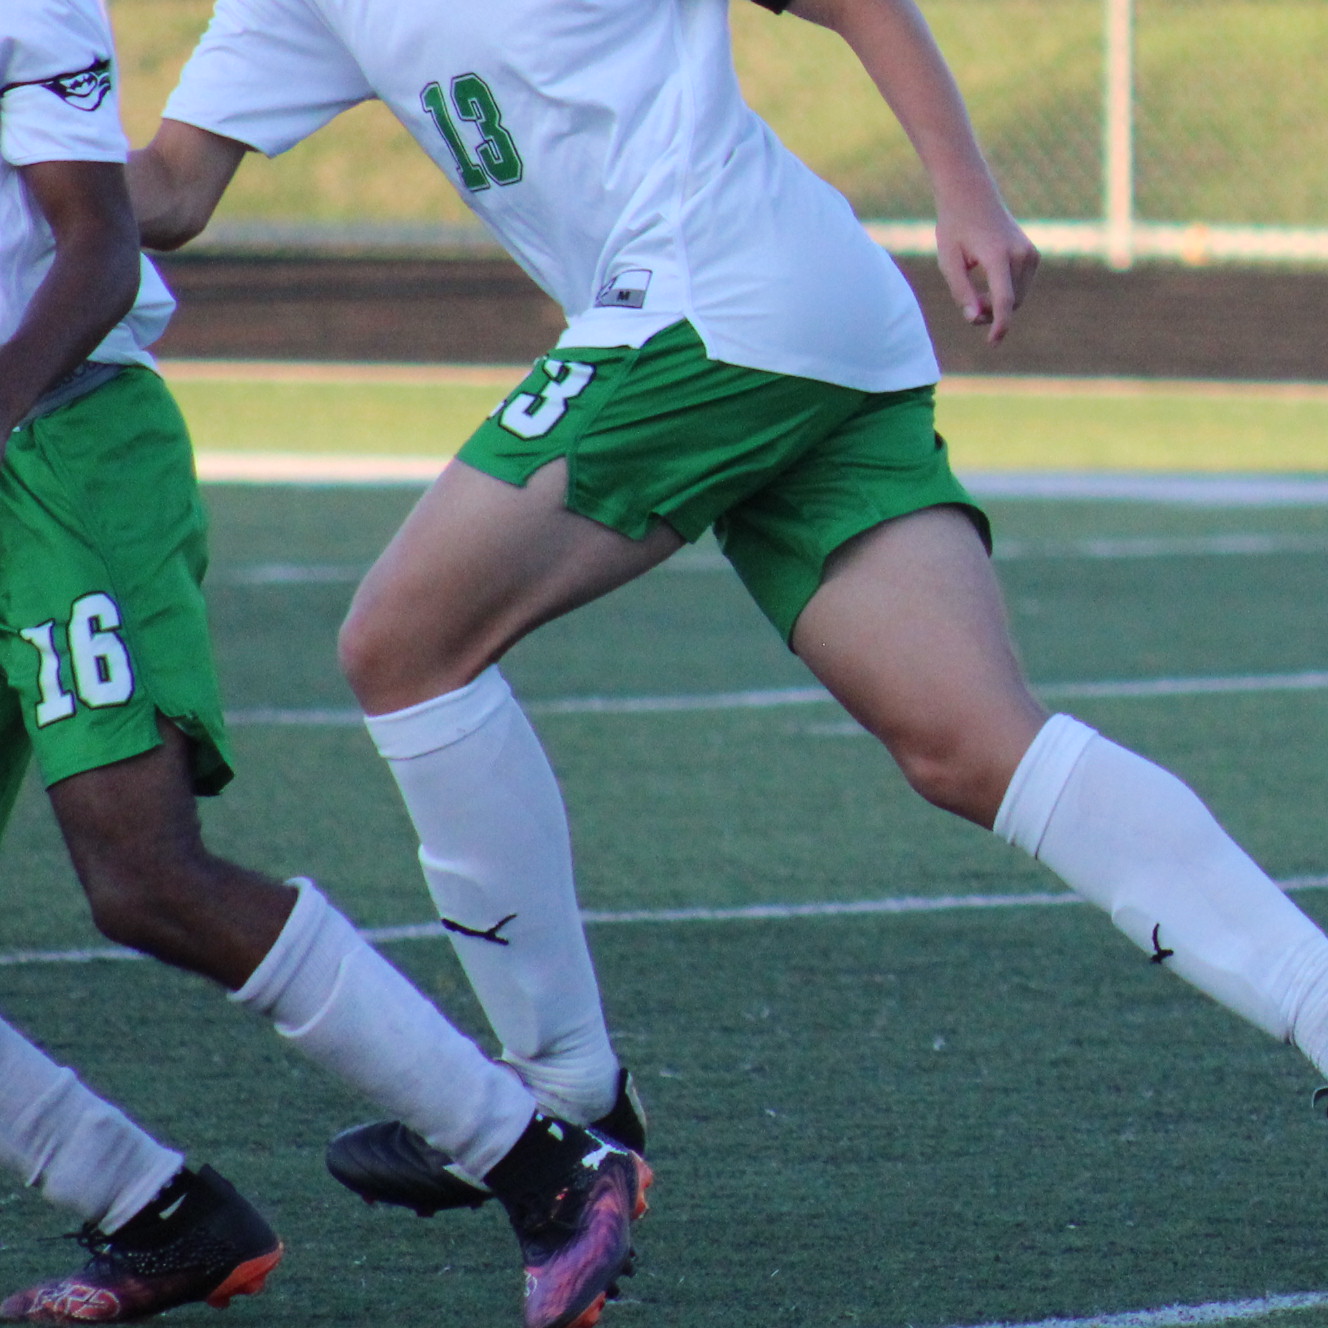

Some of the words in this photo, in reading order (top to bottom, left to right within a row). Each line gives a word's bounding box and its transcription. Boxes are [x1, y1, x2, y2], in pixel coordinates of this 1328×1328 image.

[420, 72, 523, 192] 13
[486, 355, 597, 441] 3
[19, 591, 135, 729] 16
